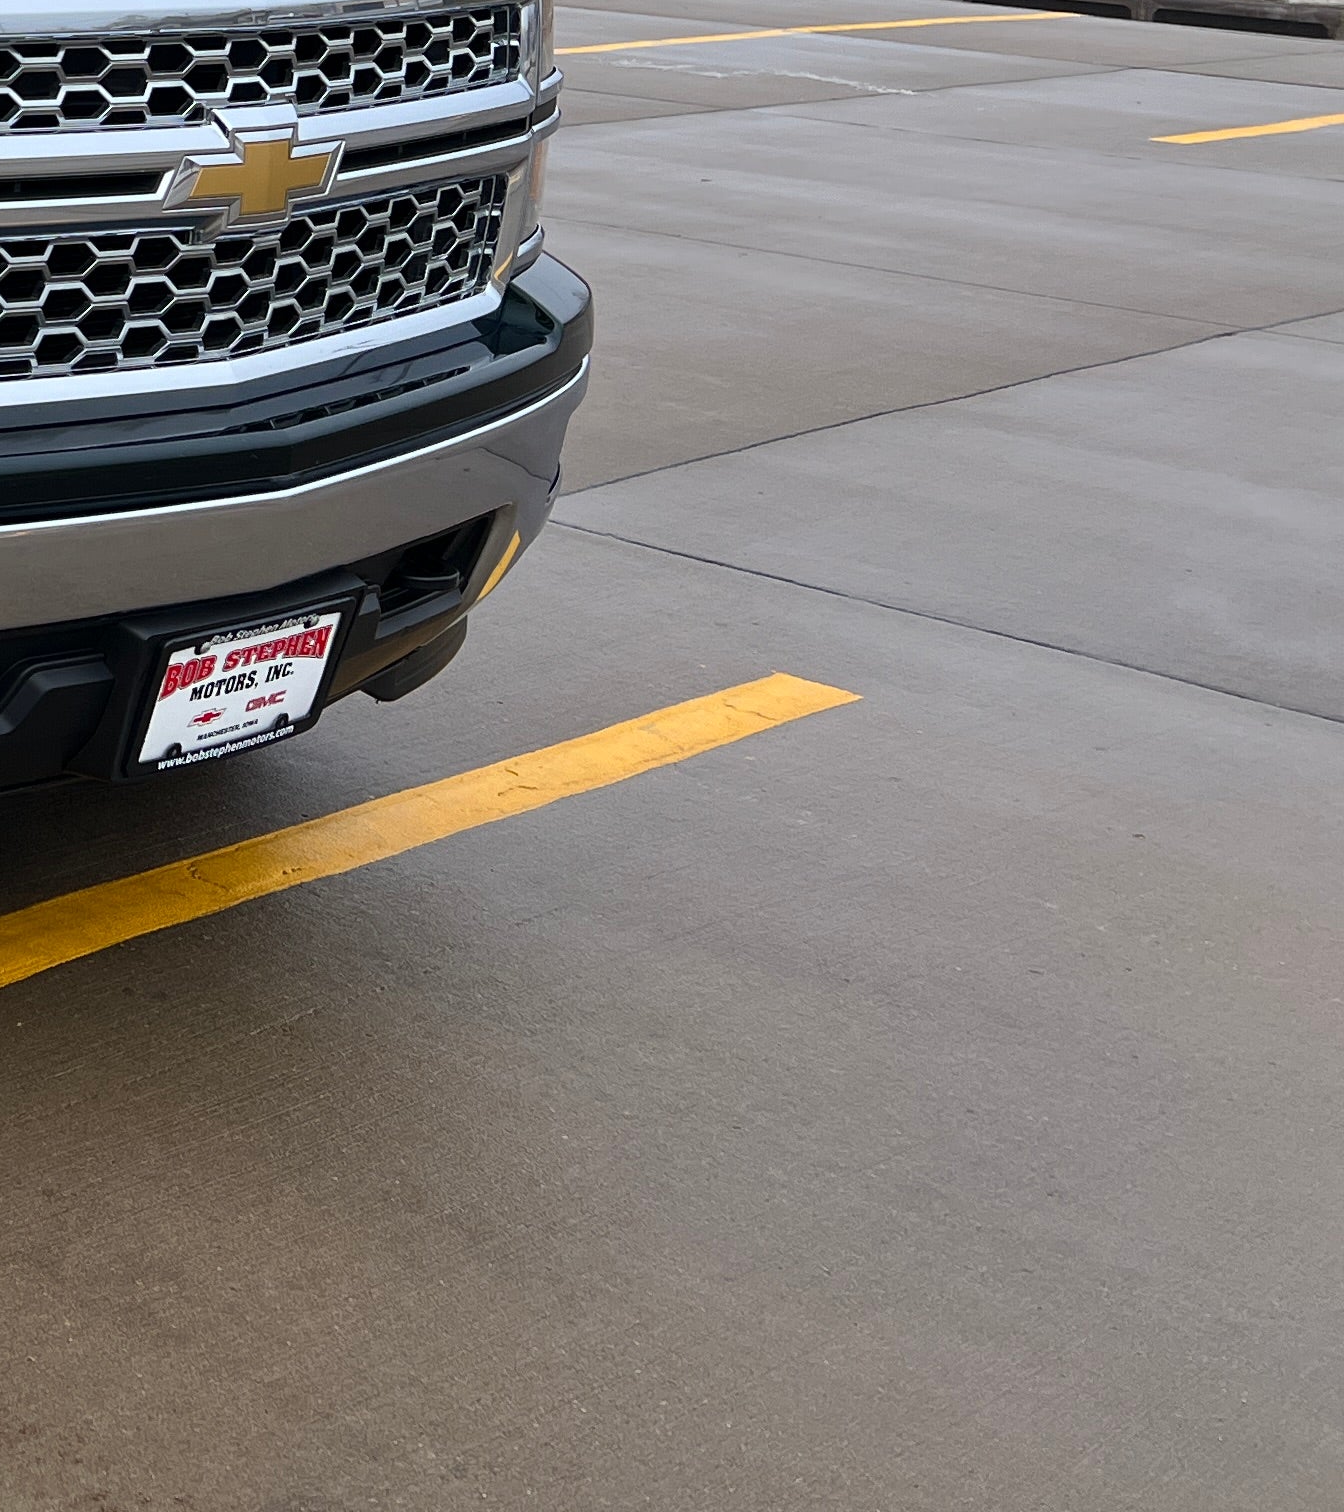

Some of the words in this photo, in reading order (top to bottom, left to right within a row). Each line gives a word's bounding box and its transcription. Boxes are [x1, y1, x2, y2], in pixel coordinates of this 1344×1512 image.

[210, 632, 233, 645] Bob
[159, 654, 216, 701] BOB
[222, 625, 333, 672] STEPHEN
[189, 670, 258, 701] MOTORS,
[265, 662, 294, 683] INC.
[245, 690, 287, 712] GMC
[158, 725, 294, 770] www.bobstephenmotors.com
